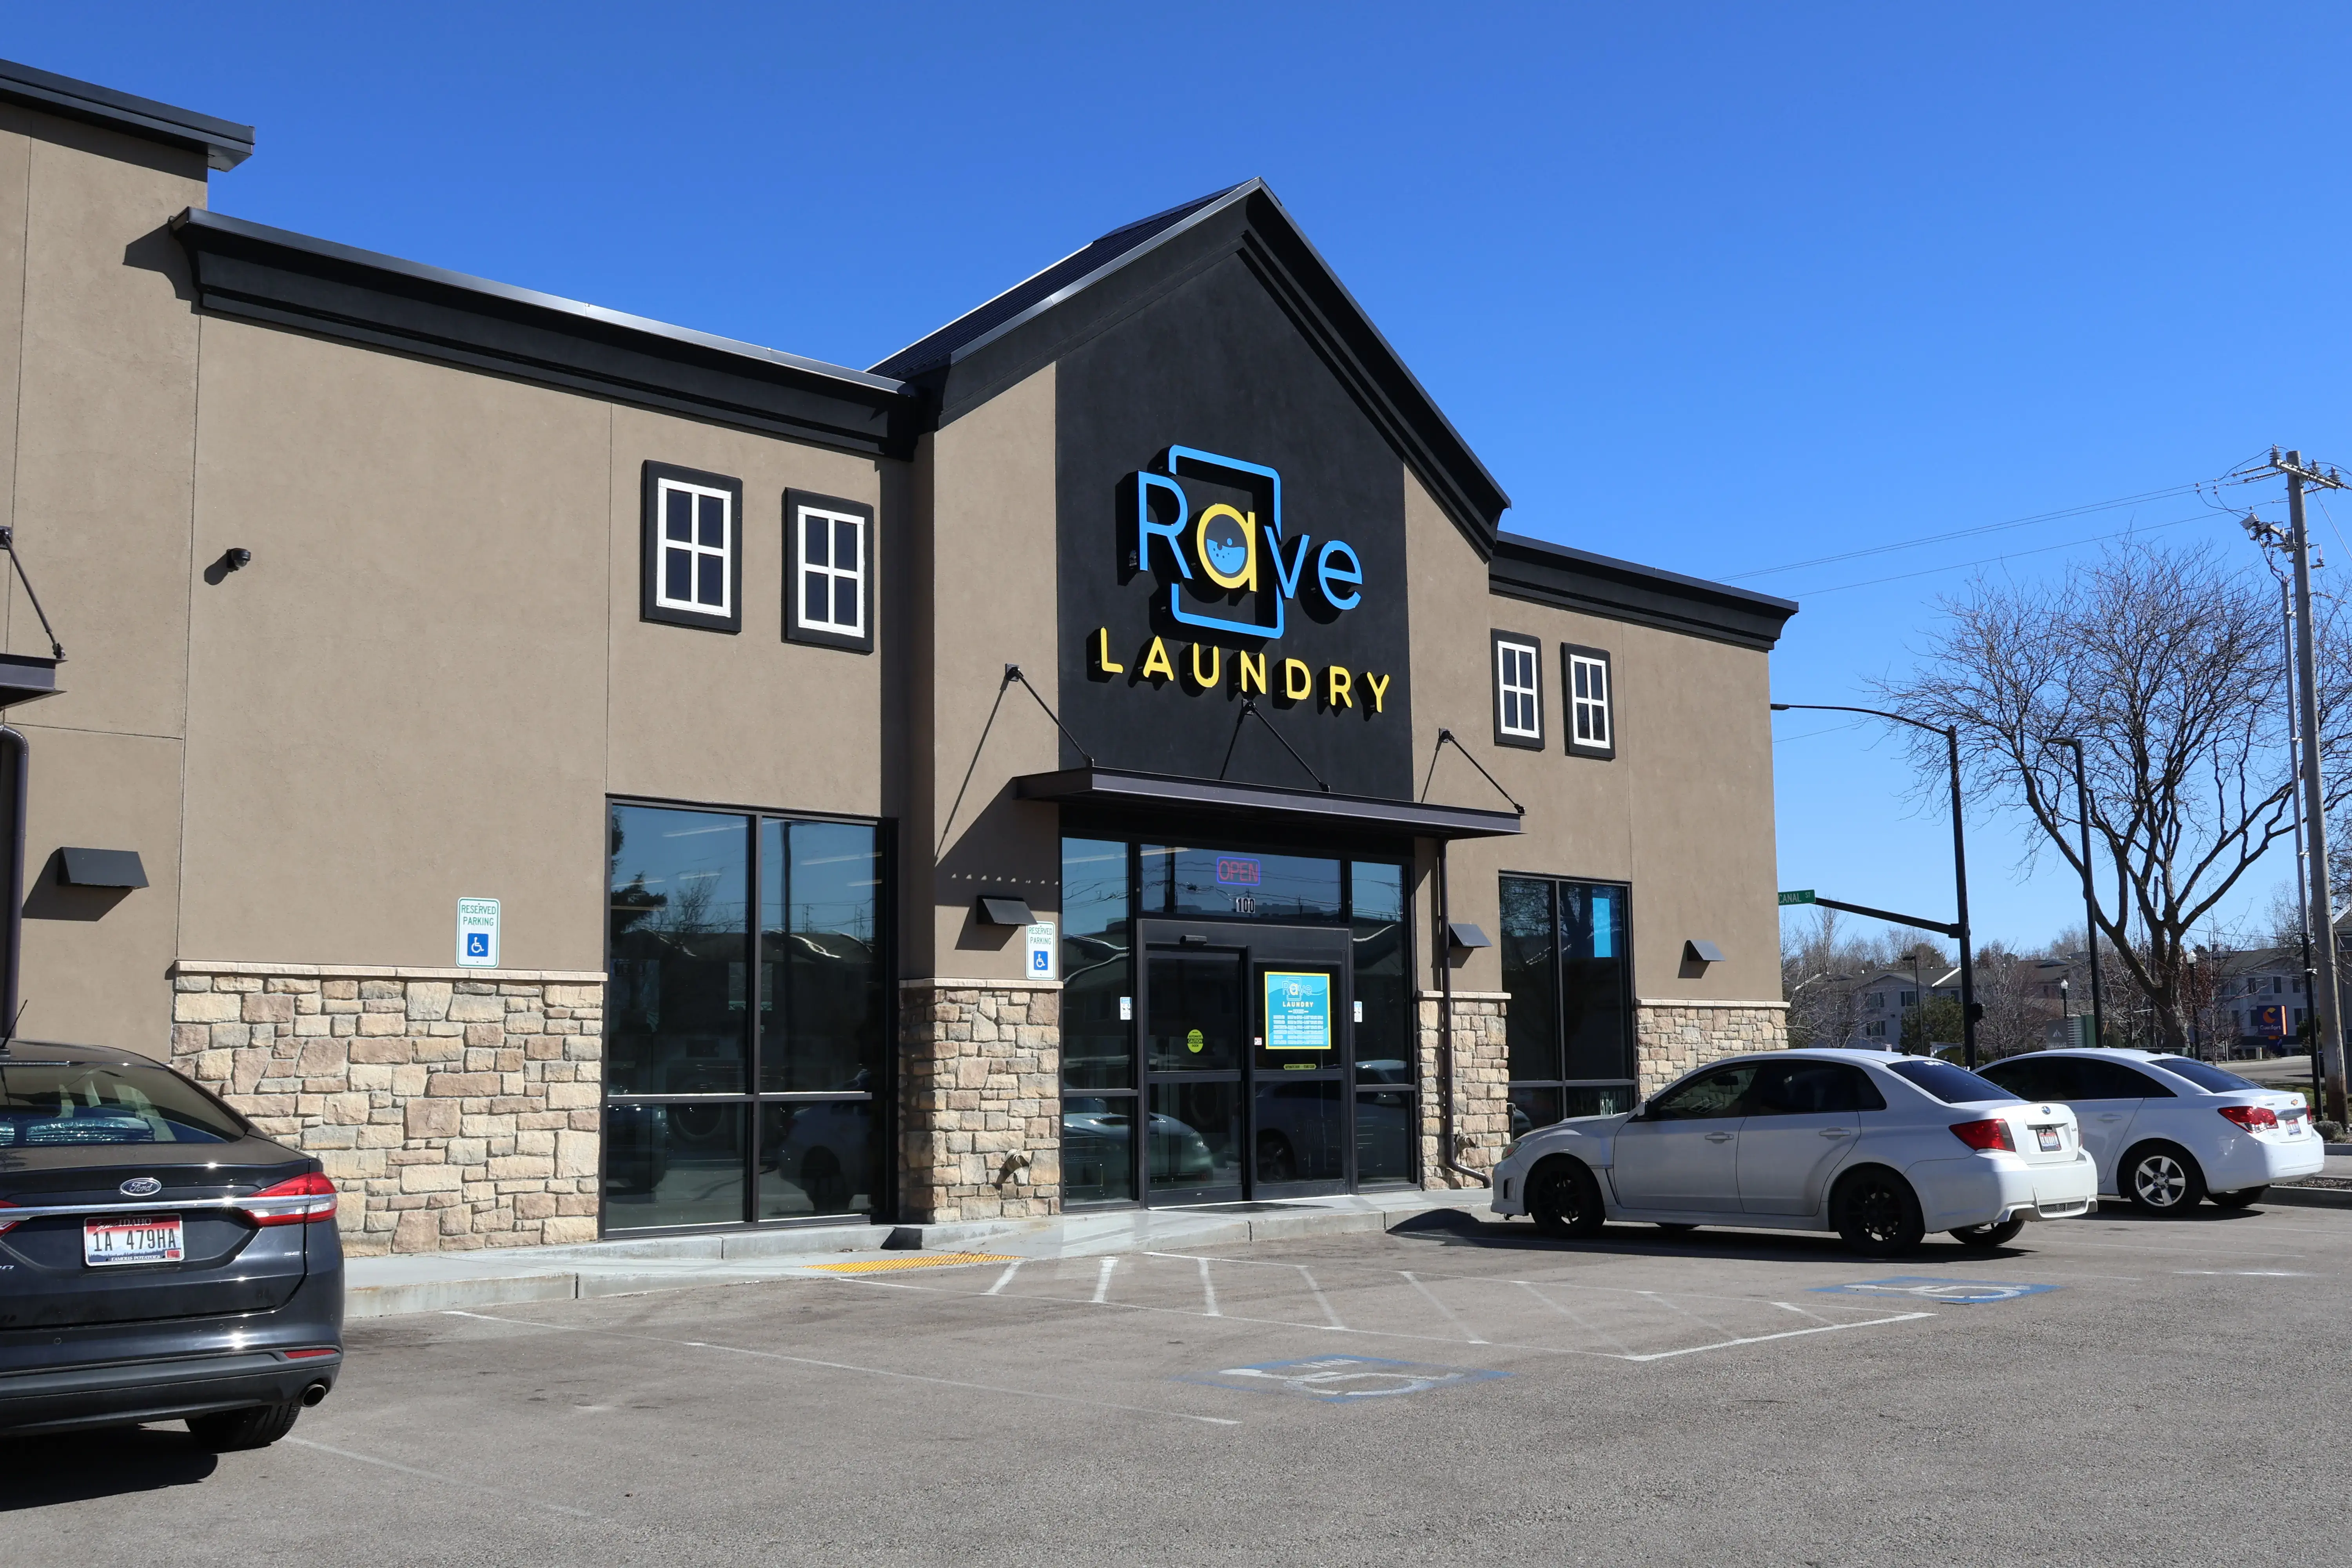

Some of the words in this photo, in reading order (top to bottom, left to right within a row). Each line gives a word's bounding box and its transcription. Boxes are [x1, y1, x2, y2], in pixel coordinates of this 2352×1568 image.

[1138, 470, 1363, 610] Rave
[1099, 626, 1390, 713] LAUNDRY
[1219, 860, 1259, 882] OPEN
[1778, 893, 1802, 904] CANAL
[461, 904, 496, 915] RESERVED
[1238, 898, 1255, 913] 100
[463, 916, 494, 926] PARKING
[1028, 927, 1053, 935] RESERVED
[1030, 936, 1052, 945] PARKING
[1282, 981, 1312, 996] Rave
[129, 1181, 153, 1193] Ford
[118, 1218, 152, 1227] IDAHO
[93, 1230, 113, 1252] 1A
[126, 1228, 176, 1250] 479HA
